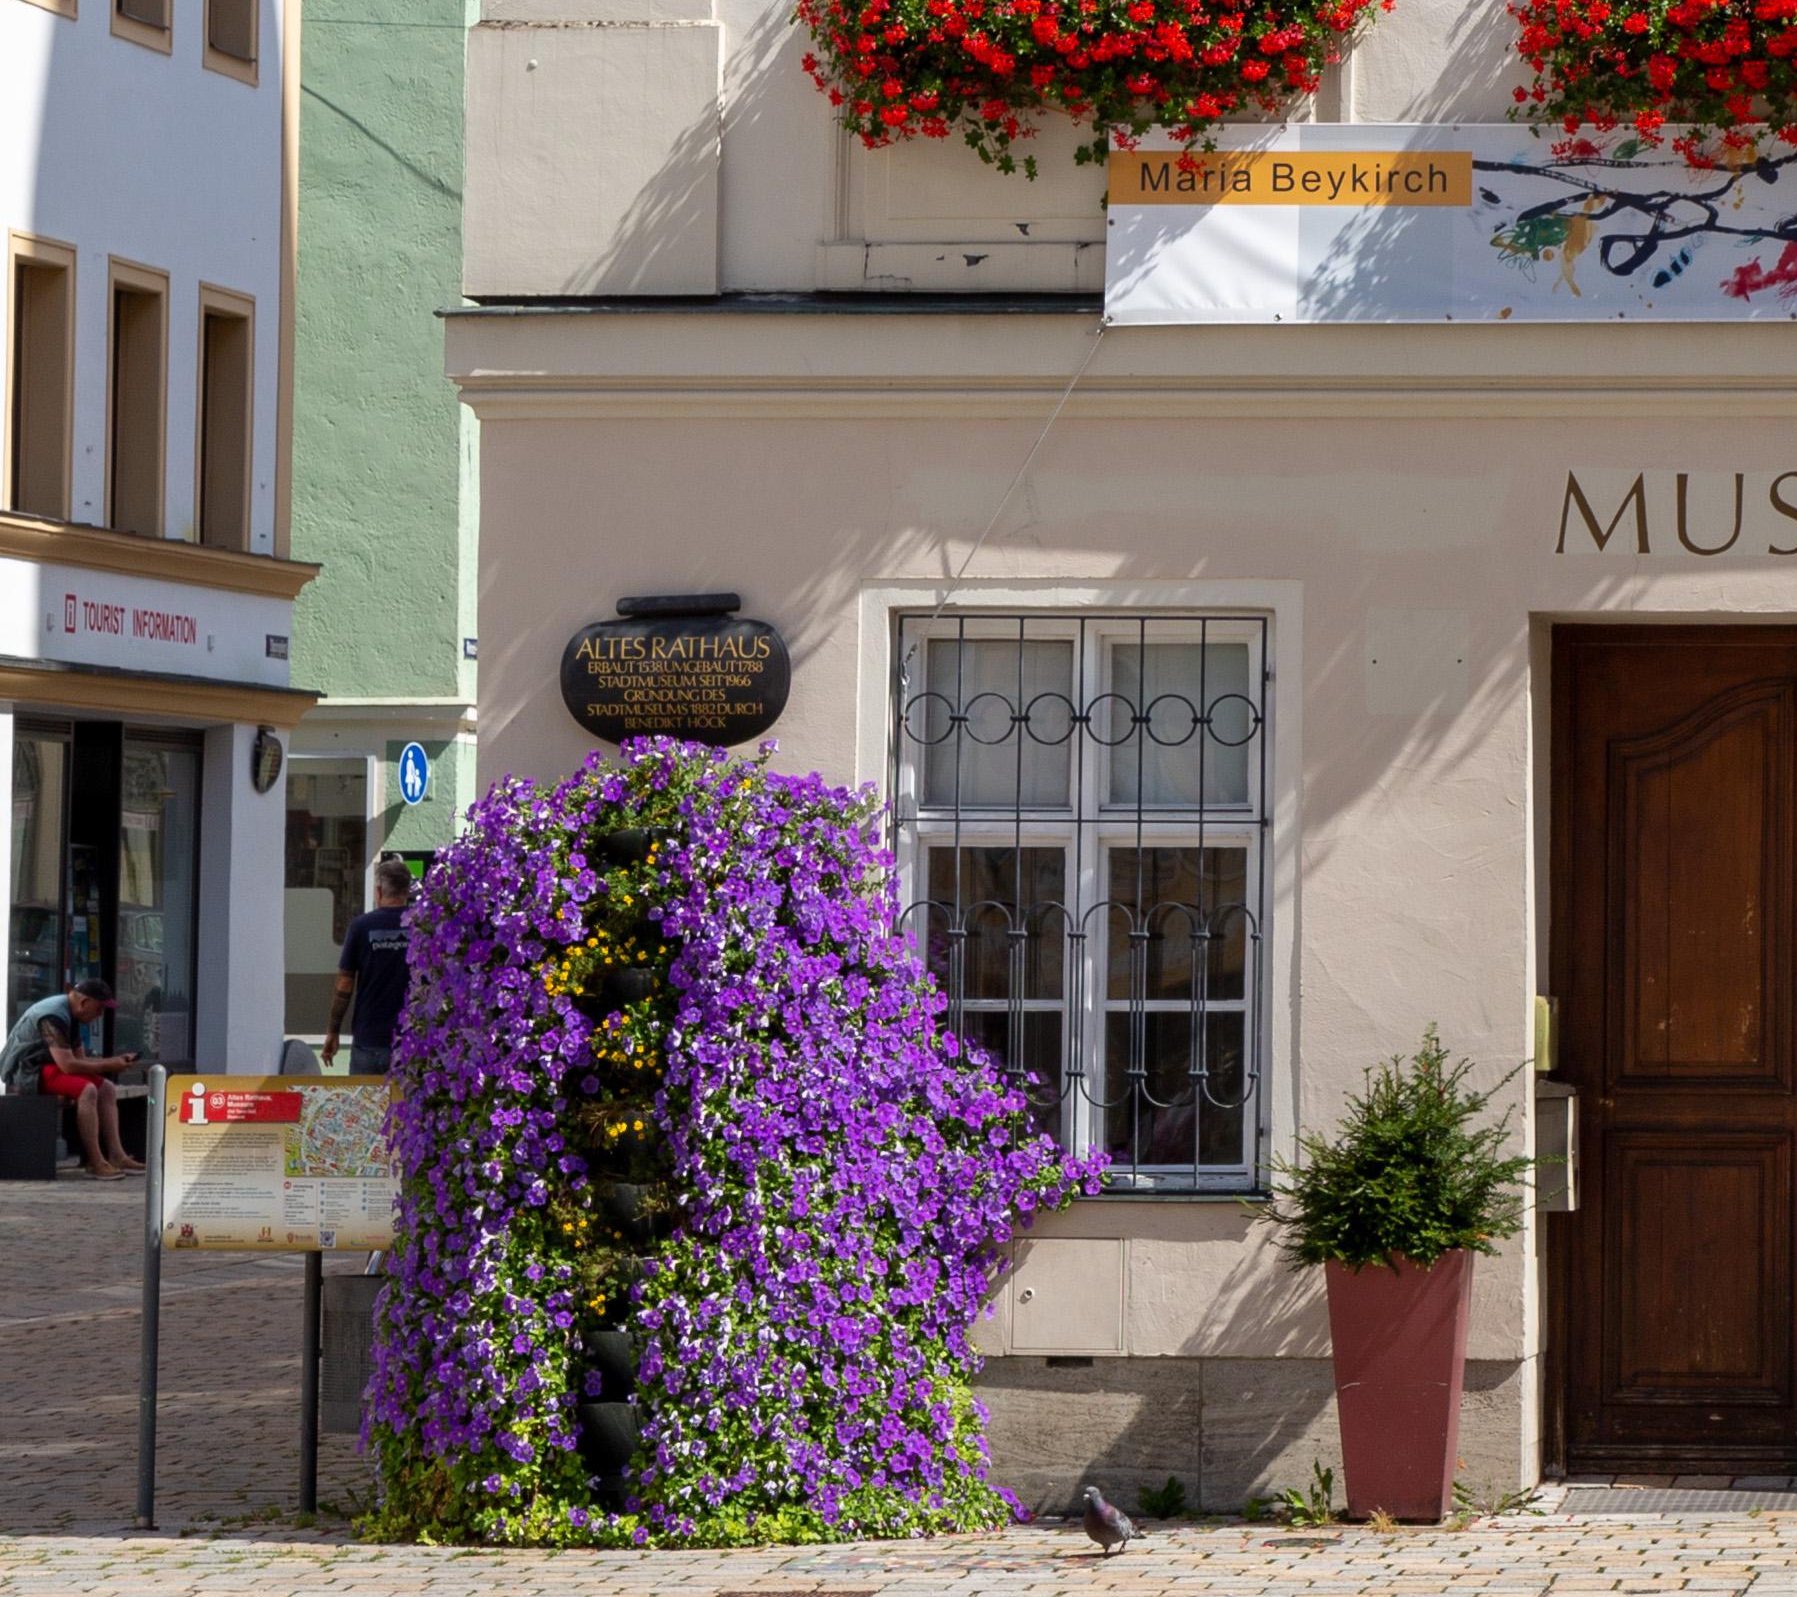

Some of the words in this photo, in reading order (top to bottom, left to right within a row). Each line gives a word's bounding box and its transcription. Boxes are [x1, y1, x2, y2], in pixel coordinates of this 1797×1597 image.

[1140, 160, 1252, 193] Maria
[1272, 161, 1449, 201] Beykirch
[83, 601, 126, 636] TOURIST
[132, 607, 197, 645] INFORMATION
[575, 636, 646, 660] ALTES
[651, 635, 771, 660] RATHAUS
[587, 660, 633, 674] ERBAUT
[637, 660, 663, 673] 1538
[663, 660, 737, 673] UMGEBAUT
[738, 660, 763, 673] 1788
[598, 675, 696, 688] STADTMUSEUM
[699, 675, 725, 687] SEIT
[725, 674, 752, 687] 1966
[623, 688, 700, 701] GRÜNDUNG
[702, 688, 726, 701] DES
[587, 702, 689, 717] STADTMUSEUMS
[690, 703, 716, 715] 1882
[717, 702, 763, 715] DURCH
[624, 716, 683, 729] BENEDIKT
